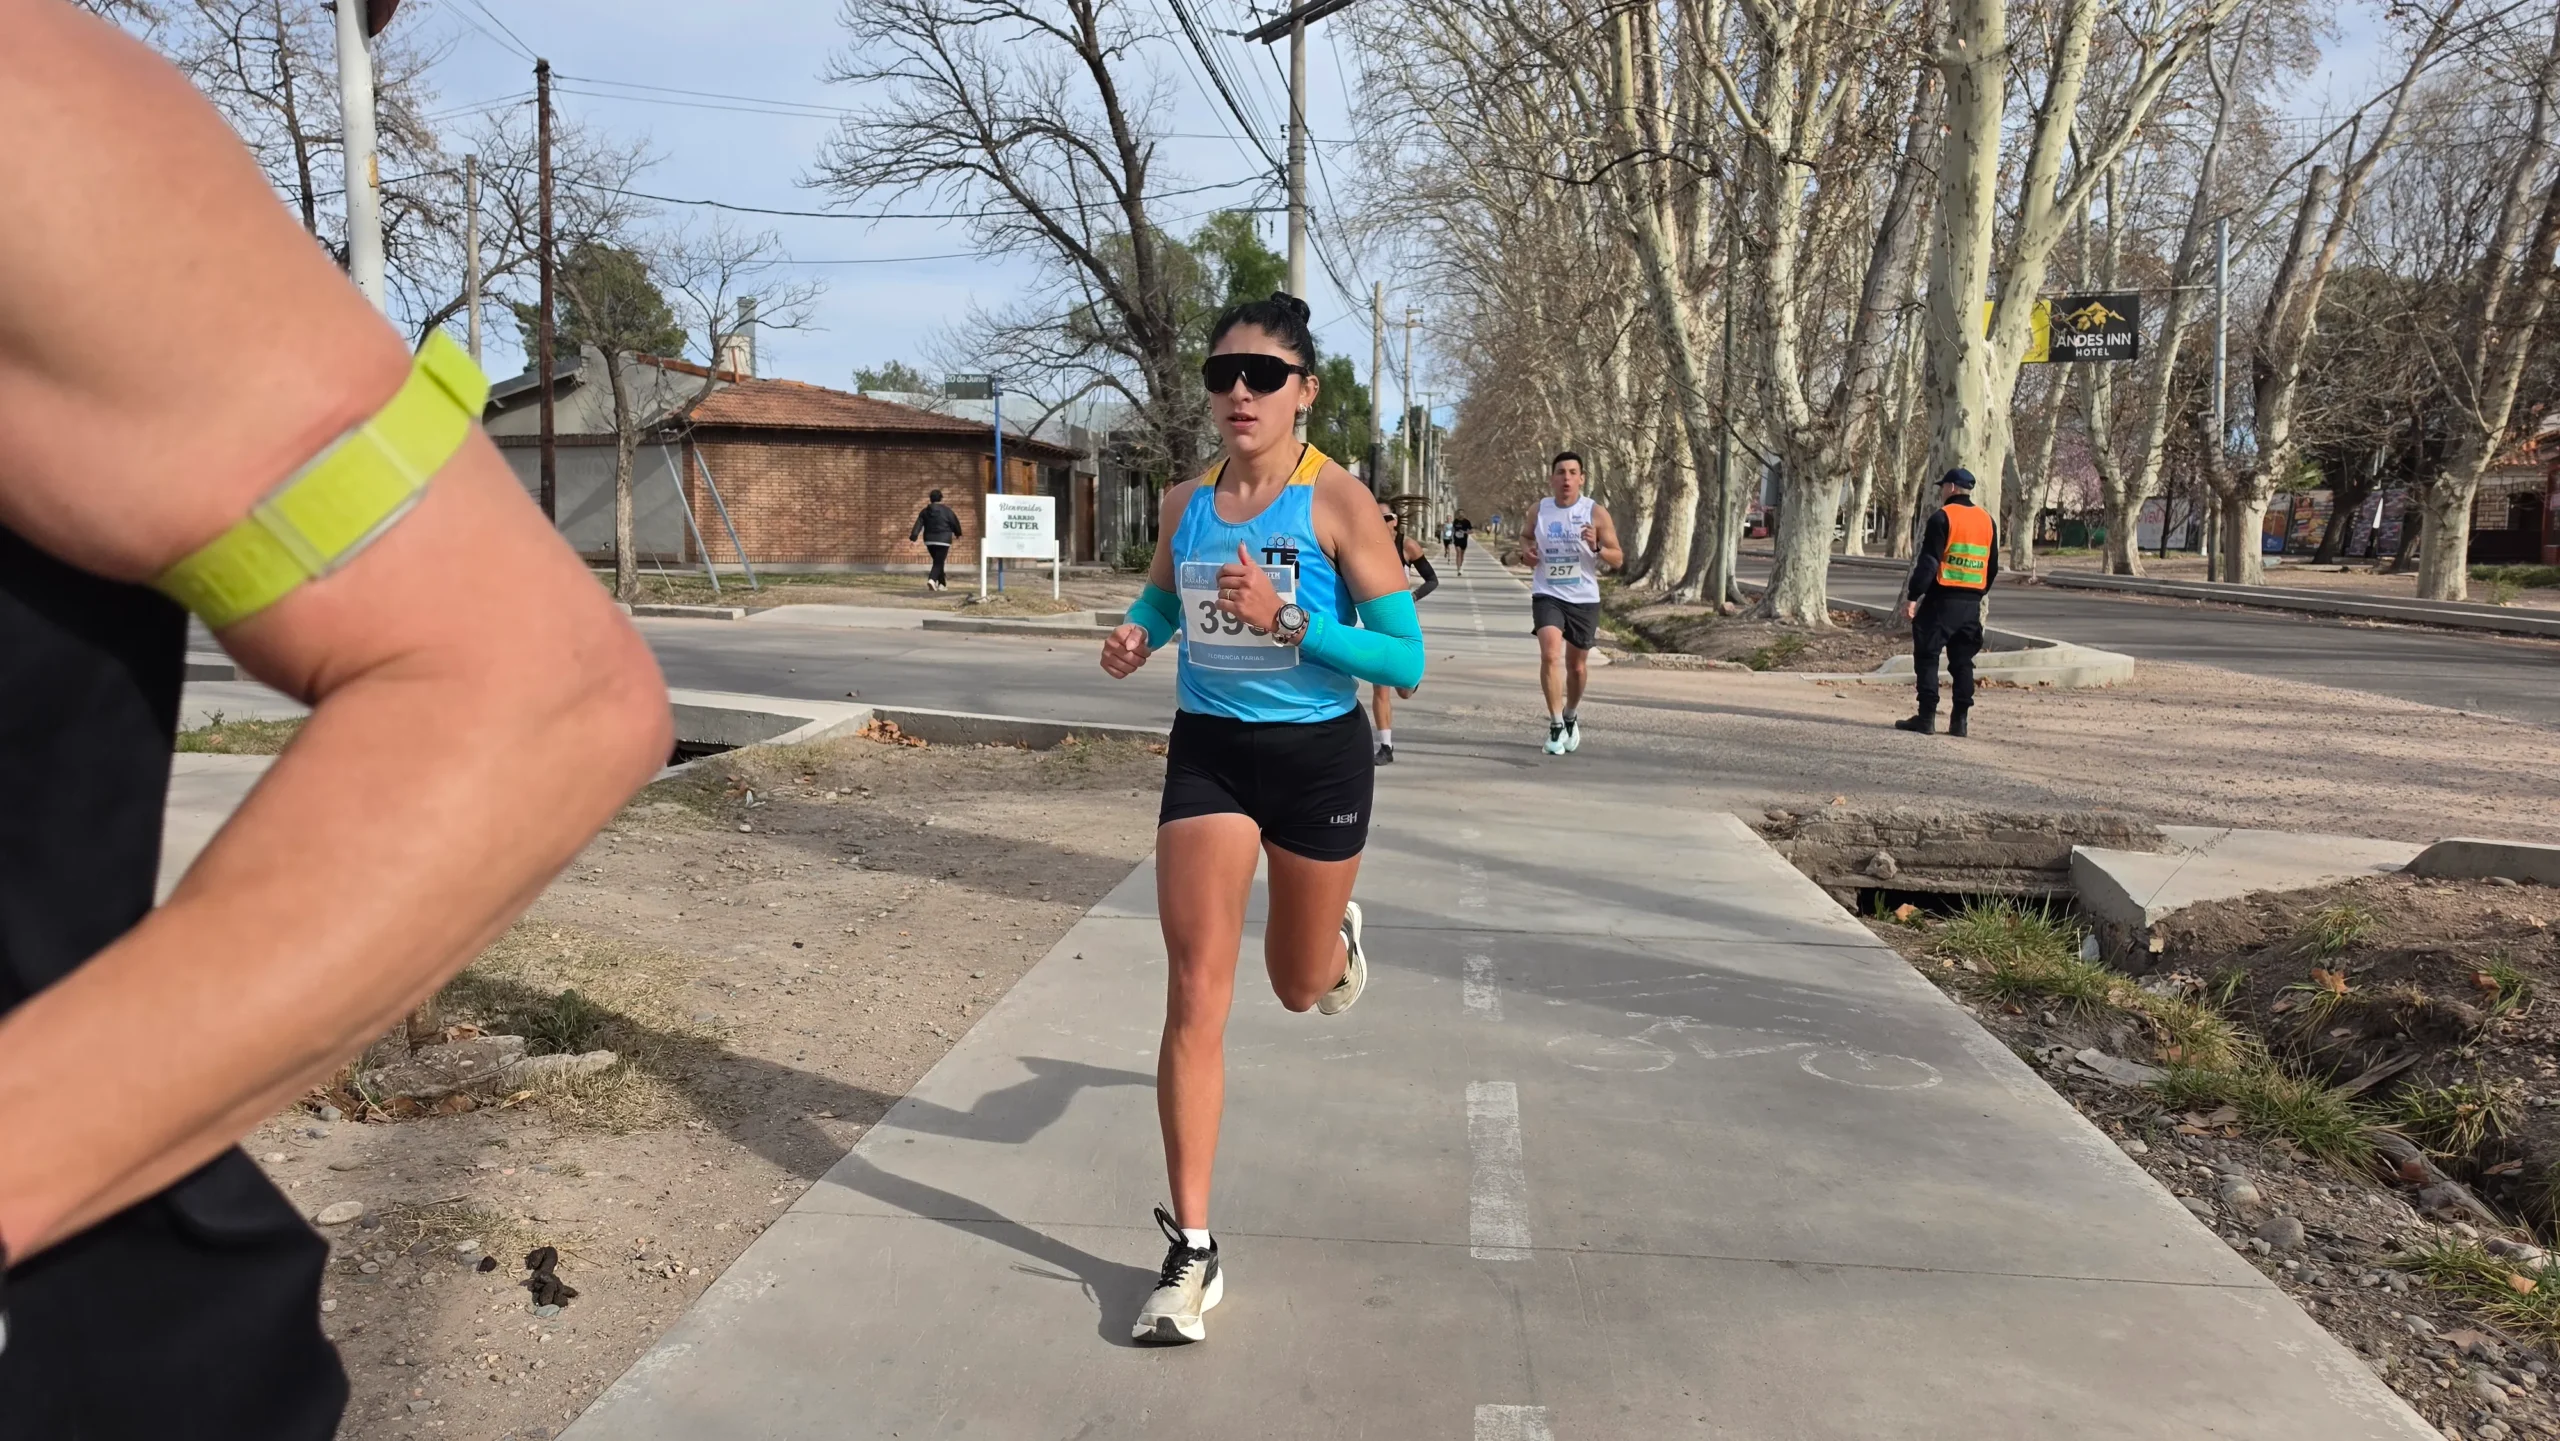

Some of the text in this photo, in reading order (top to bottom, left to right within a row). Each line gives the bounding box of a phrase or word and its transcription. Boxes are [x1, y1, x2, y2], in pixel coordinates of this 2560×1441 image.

[2056, 333, 2104, 348] ANDES
[2107, 332, 2131, 346] INN
[2075, 347, 2110, 357] HOTEL
[946, 374, 988, 383] 20 de Junio
[999, 502, 1042, 512] Bienvenidos
[1003, 521, 1039, 530] SUTER
[1550, 565, 1573, 576] 257
[1199, 600, 1267, 637] 39
[1208, 653, 1240, 661] FLORENCIA
